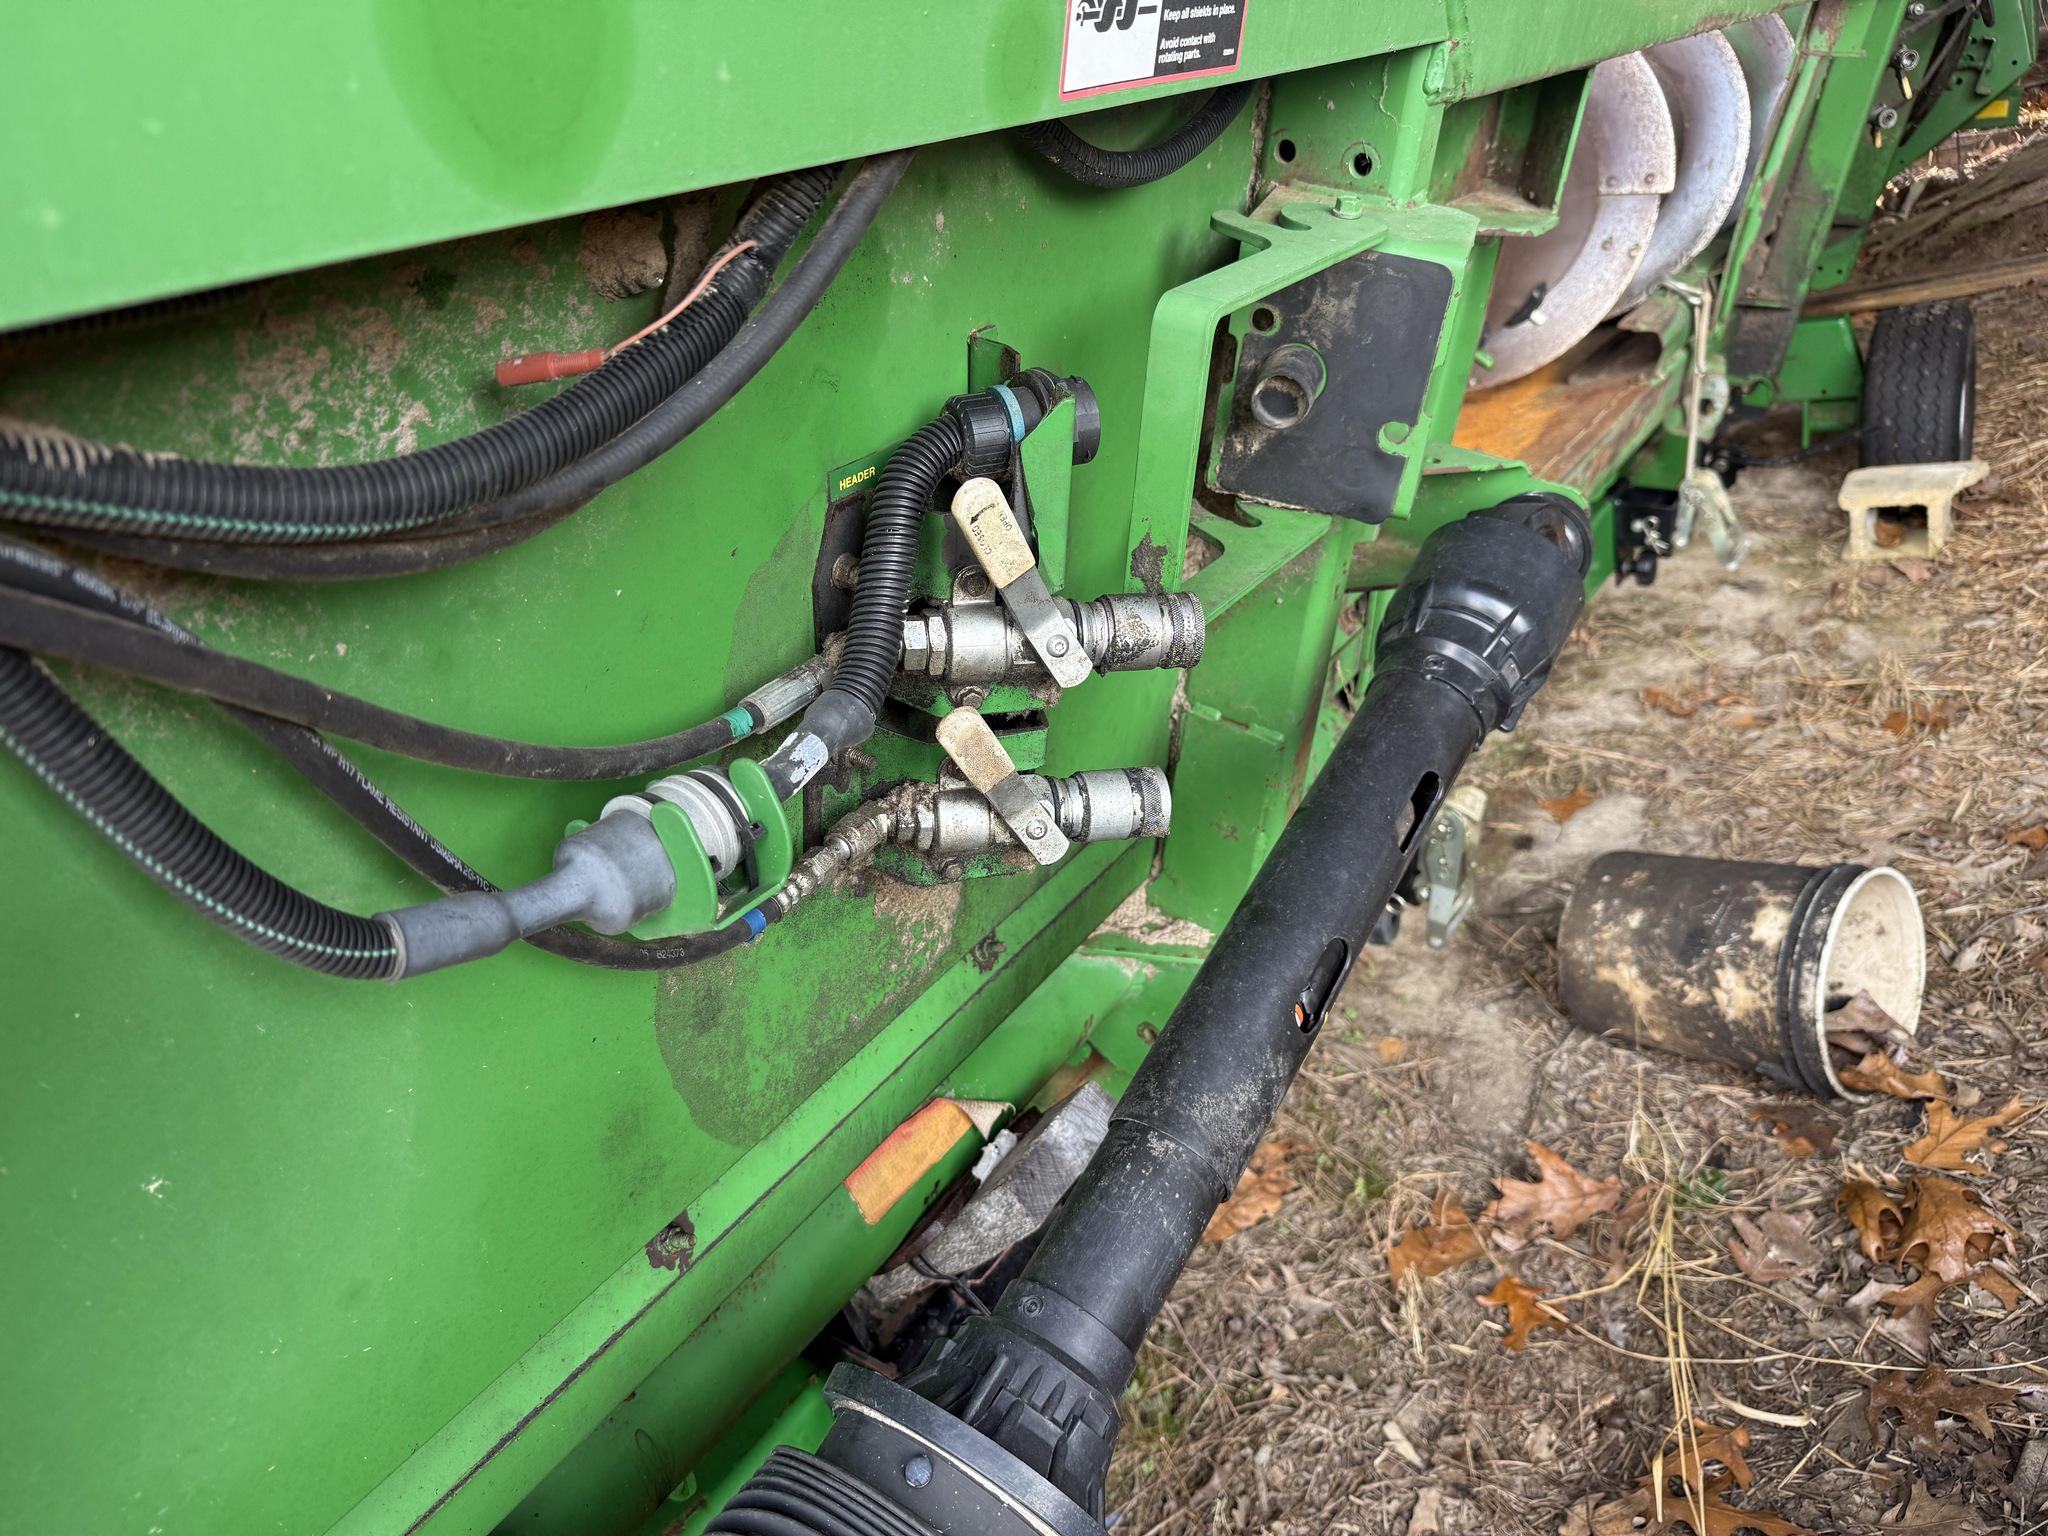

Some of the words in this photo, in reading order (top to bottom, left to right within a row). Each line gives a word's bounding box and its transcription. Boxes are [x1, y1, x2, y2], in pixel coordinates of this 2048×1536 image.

[1164, 9, 1180, 23] Keep
[1181, 7, 1190, 19] all
[1190, 5, 1212, 18] shields
[1212, 4, 1219, 16] in
[1219, 3, 1236, 18] place.
[1160, 36, 1180, 50] Avoid
[1180, 34, 1203, 47] contact
[1203, 32, 1216, 44] with
[1158, 51, 1183, 64] rotating
[1183, 48, 1201, 63] parts.
[839, 466, 876, 491] HEADER
[971, 525, 992, 555] CLOSED
[356, 771, 385, 805] FLAME
[385, 797, 429, 843] RESISTANT
[656, 947, 686, 959] B24373
